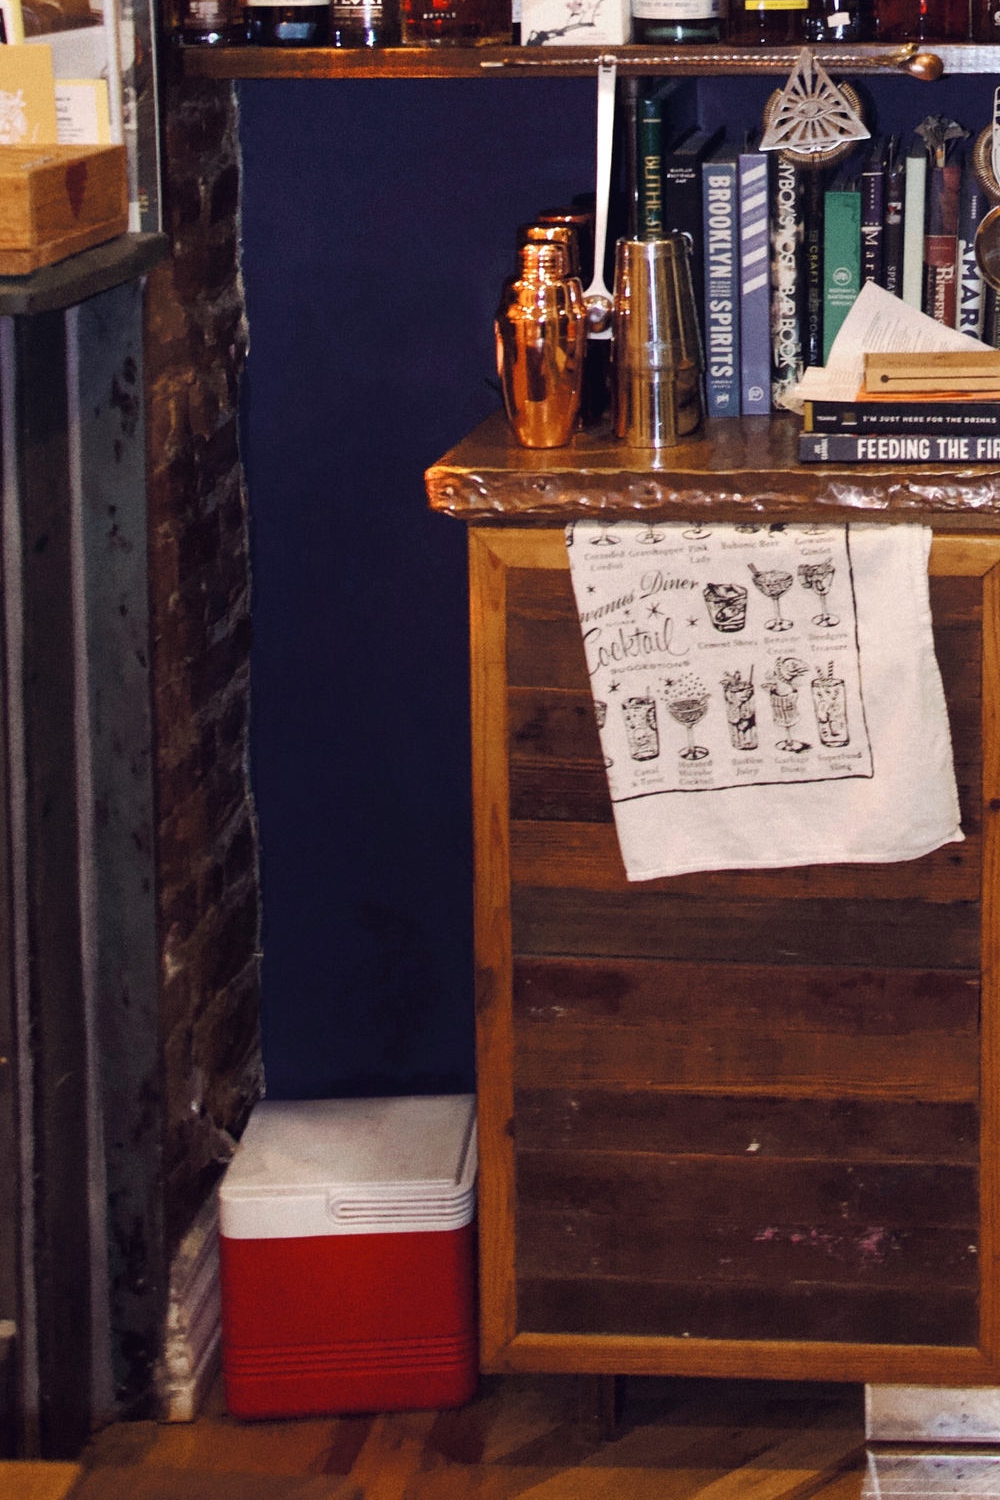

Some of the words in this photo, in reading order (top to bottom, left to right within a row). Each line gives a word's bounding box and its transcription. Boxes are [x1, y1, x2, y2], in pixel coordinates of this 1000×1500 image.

[778, 162, 796, 227] AYBOY'S
[708, 175, 732, 277] BROOKLYN
[809, 245, 819, 285] CRAFT
[709, 299, 732, 377] SPIRITS
[779, 320, 797, 368] BOOK
[809, 314, 819, 366] COCKTAI
[857, 439, 930, 460] FEEDING
[937, 438, 972, 460] THE
[580, 591, 635, 624] wanus
[639, 570, 700, 601] Diner
[584, 618, 691, 677] Cocktail
[610, 660, 690, 674] SUGGESTIONS
